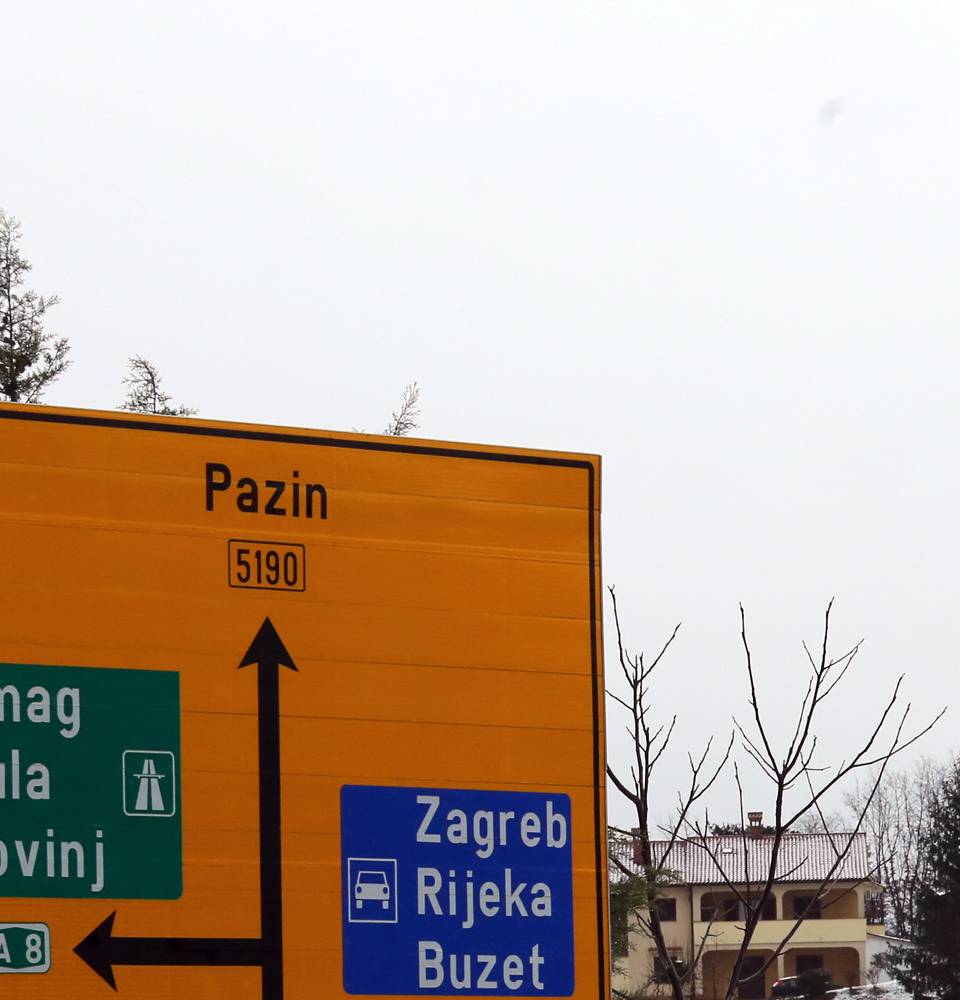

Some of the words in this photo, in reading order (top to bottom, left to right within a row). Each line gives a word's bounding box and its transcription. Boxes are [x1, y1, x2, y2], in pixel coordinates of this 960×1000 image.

[205, 462, 328, 519] Pazin
[236, 549, 298, 586] 5190
[0, 749, 50, 800] la
[416, 796, 567, 859] Zagreb
[417, 867, 552, 929] Rijeka
[25, 933, 42, 964] 8
[418, 940, 545, 990] Buzet
